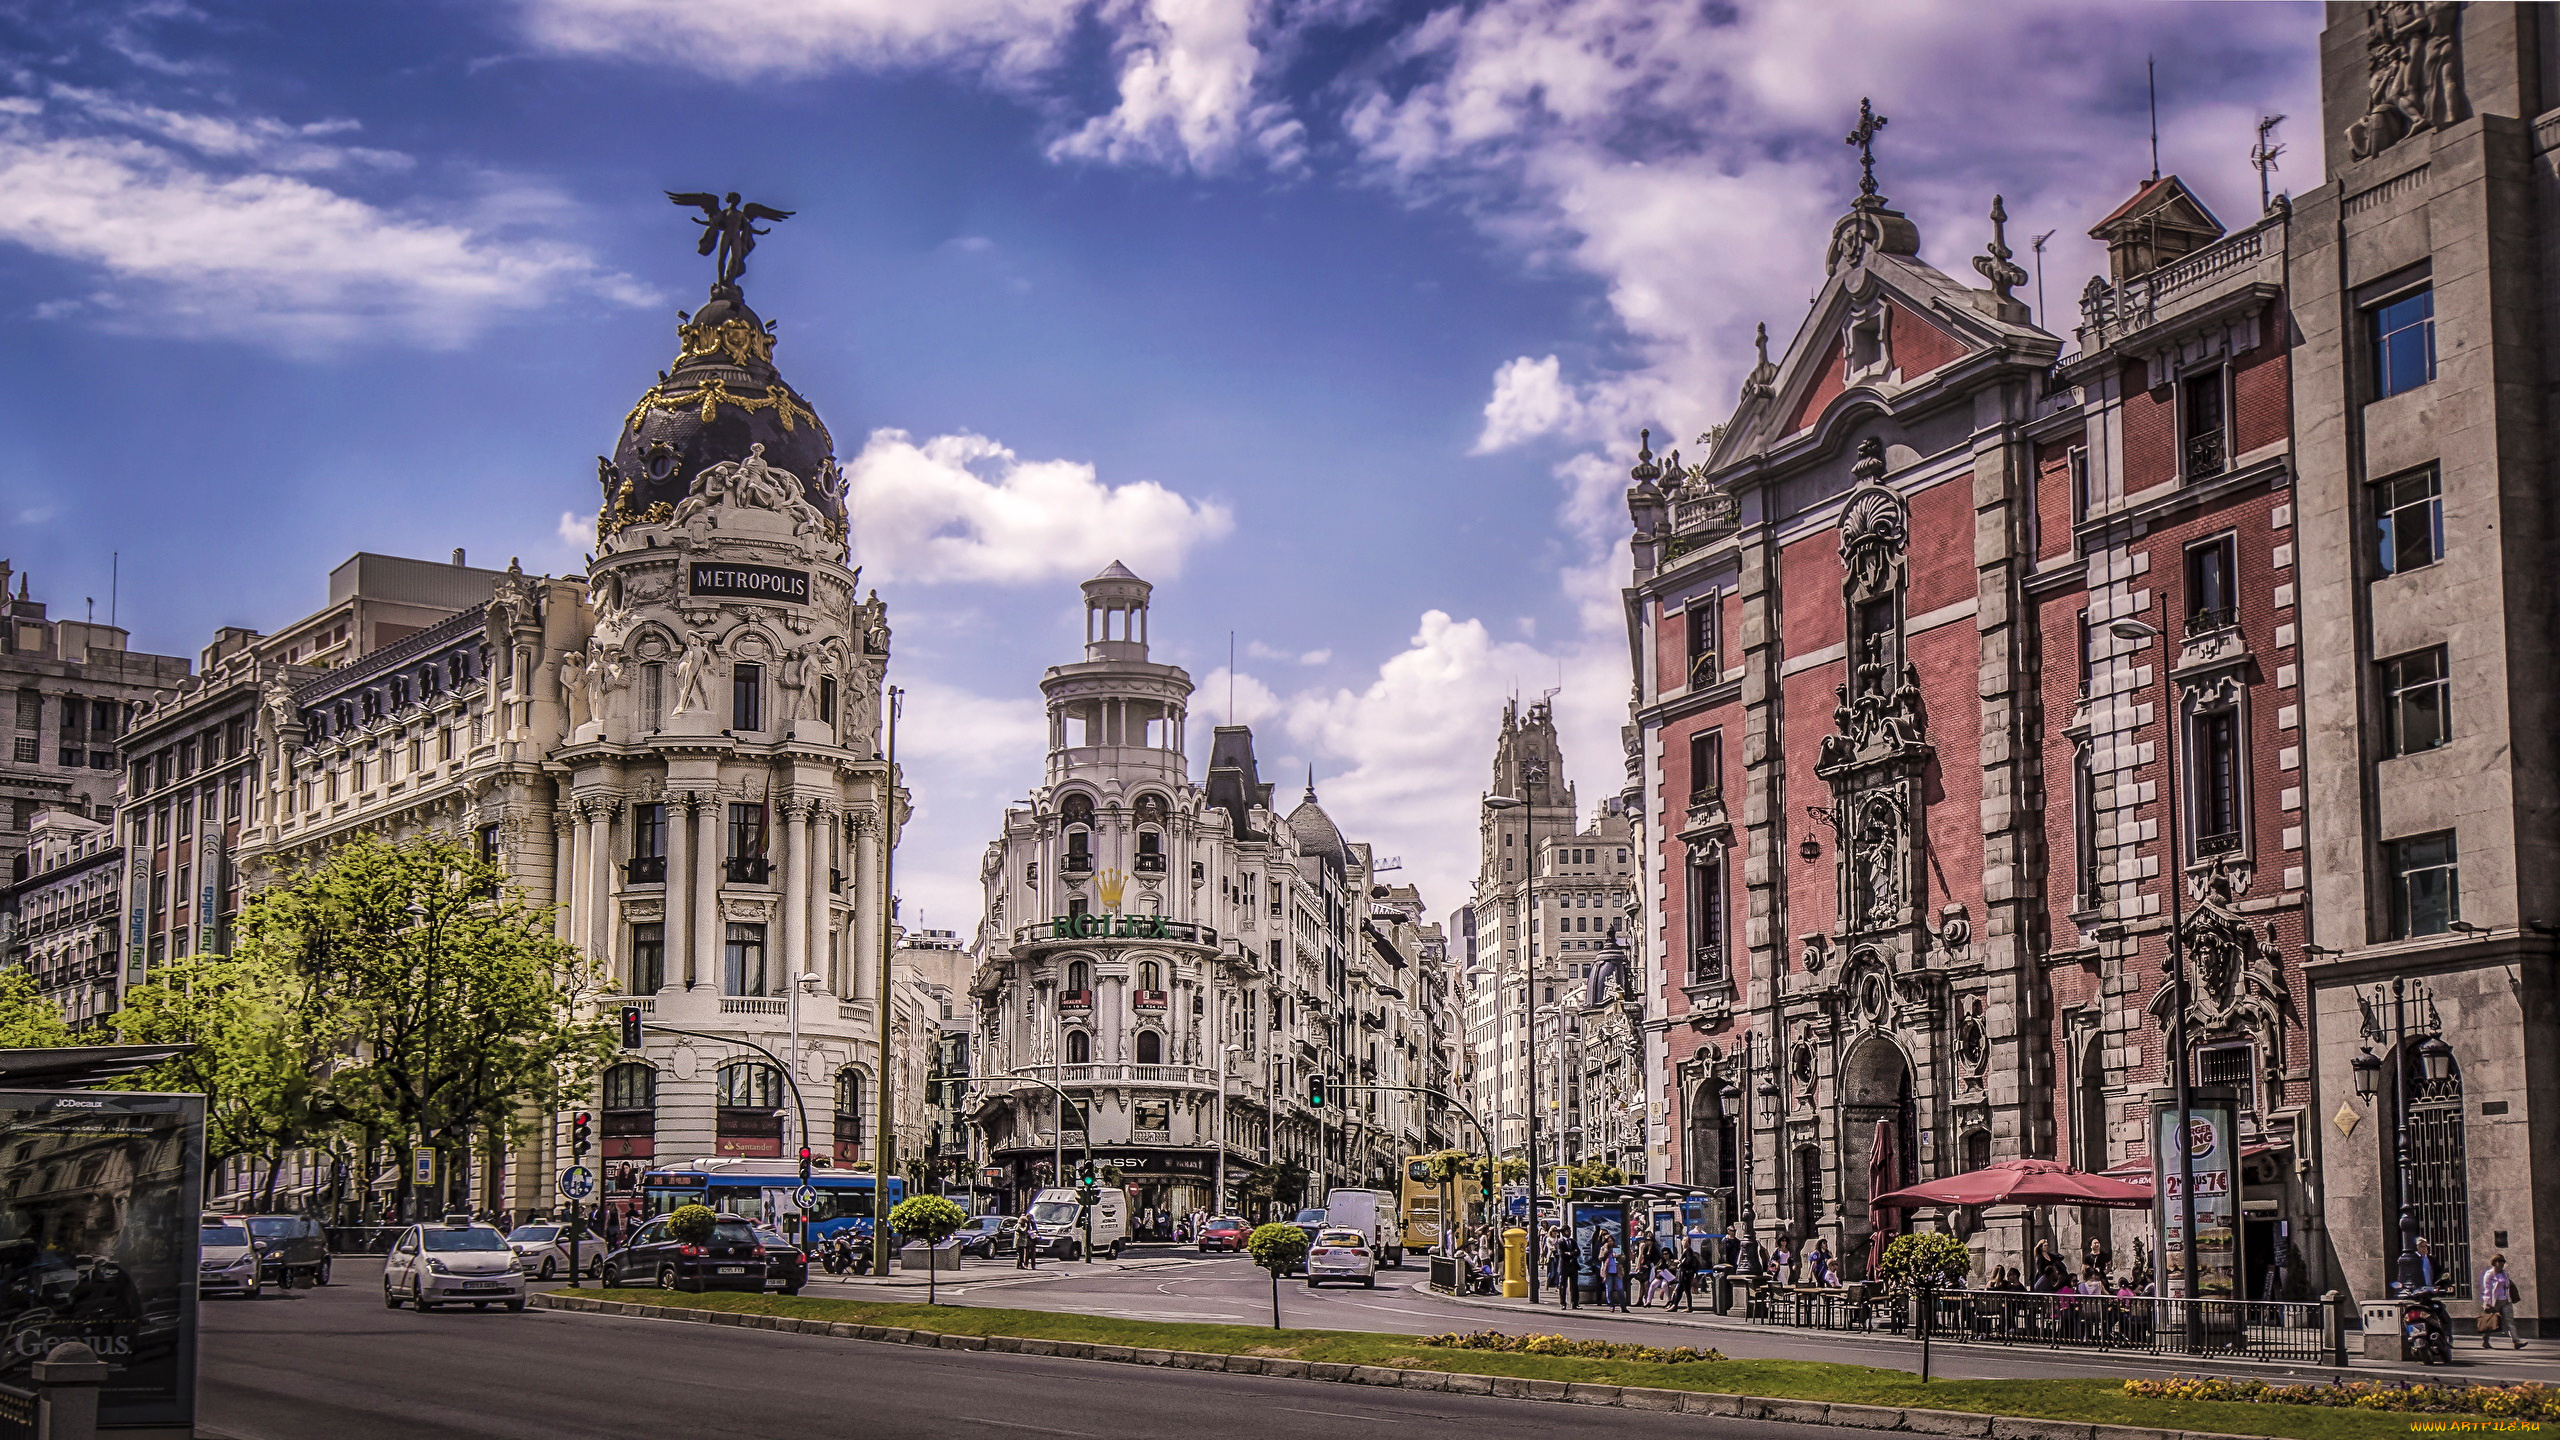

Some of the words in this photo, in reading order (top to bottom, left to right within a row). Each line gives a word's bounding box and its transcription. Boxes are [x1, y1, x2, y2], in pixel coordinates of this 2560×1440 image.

[698, 570, 805, 596] METROPOLIS
[202, 886, 214, 925] salida
[131, 908, 143, 945] salida
[1051, 913, 1173, 939] ROLEX
[201, 926, 215, 951] hay
[130, 946, 144, 970] hay
[55, 1098, 103, 1108] JCDecaux
[2190, 1124, 2212, 1135] RGER
[2192, 1132, 2213, 1146] ING
[735, 1143, 773, 1151] Santander
[2167, 1176, 2178, 1195] 2
[2207, 1172, 2227, 1192] 7€
